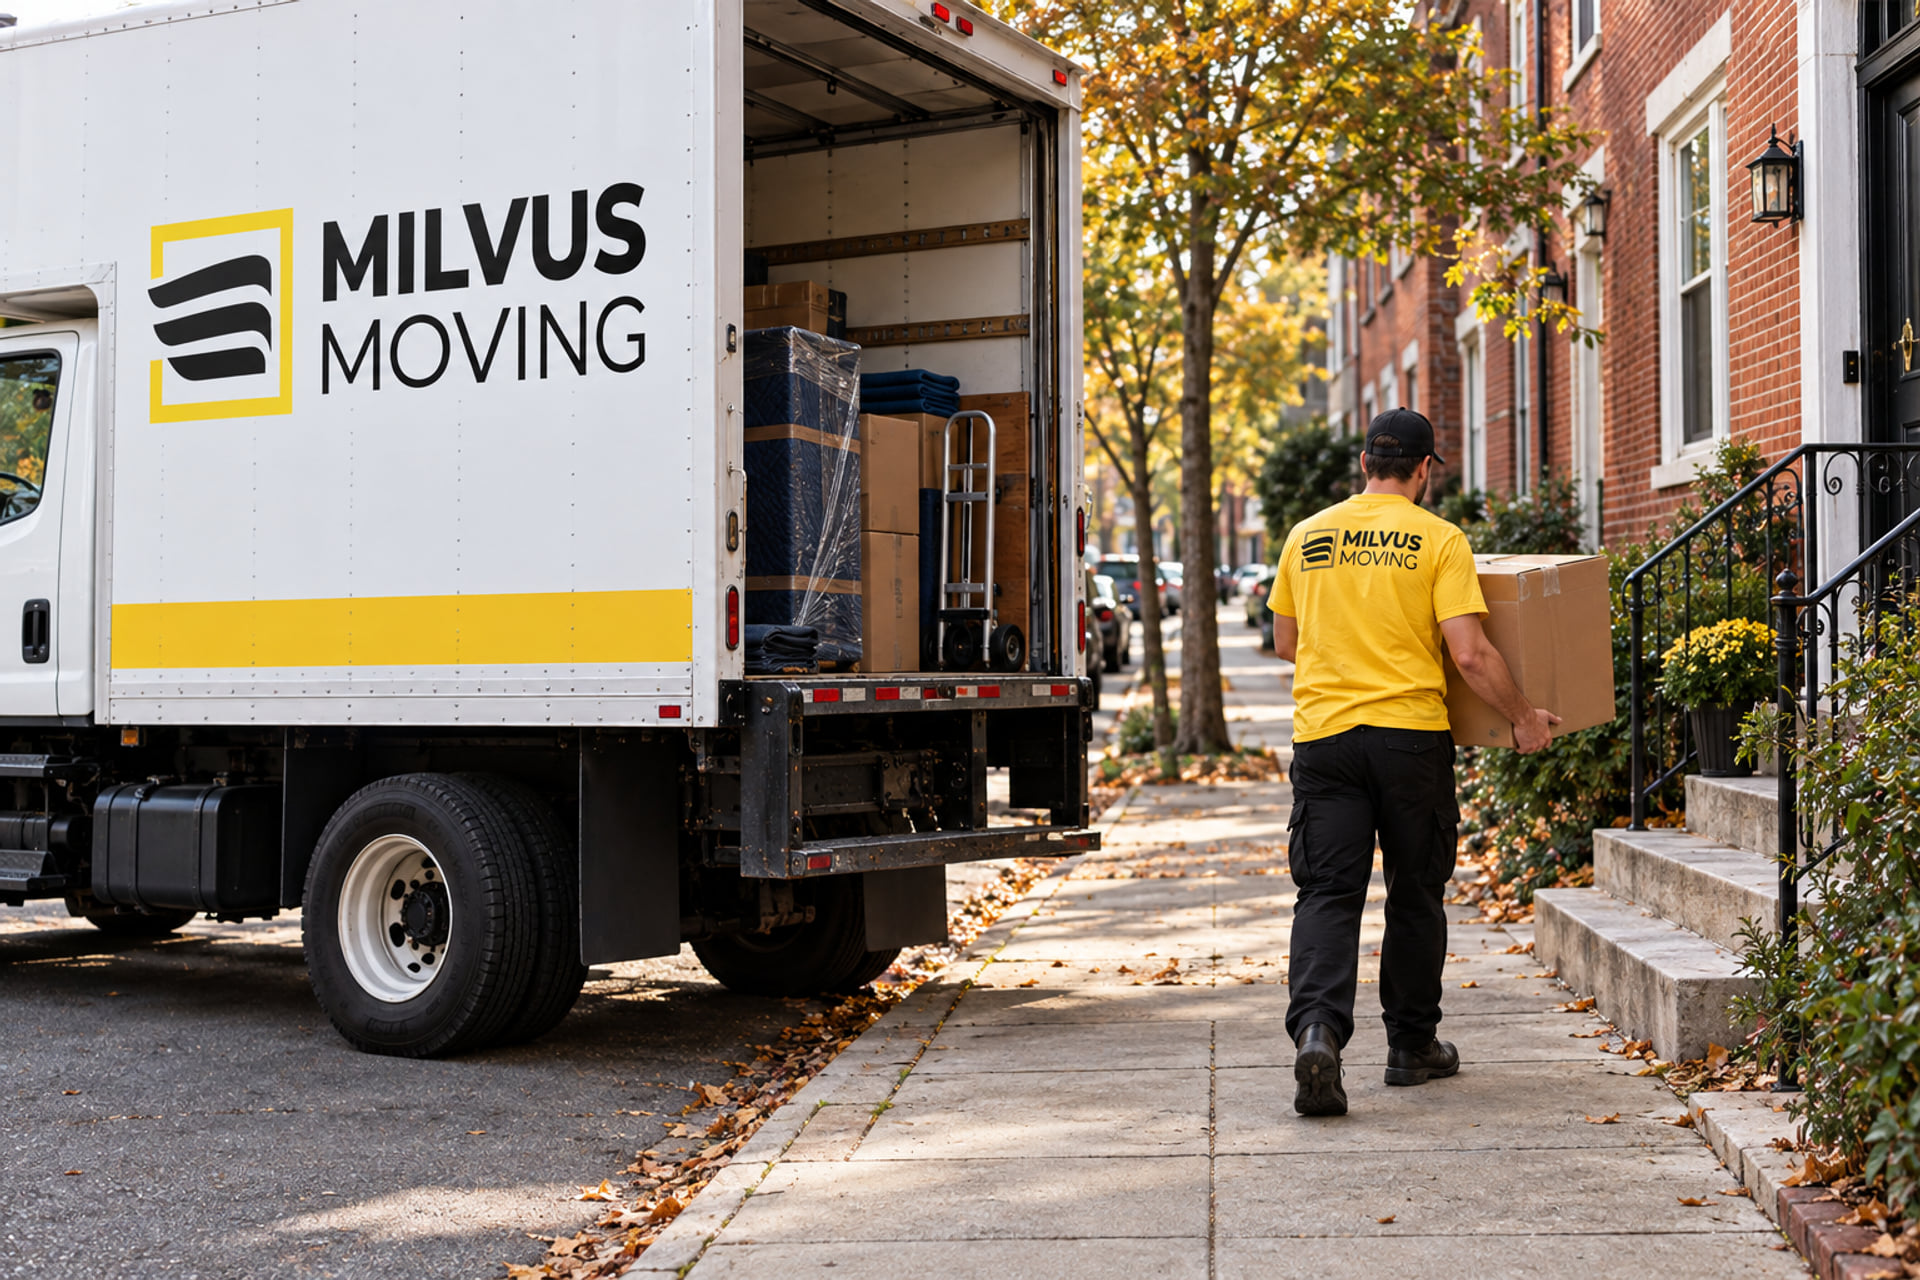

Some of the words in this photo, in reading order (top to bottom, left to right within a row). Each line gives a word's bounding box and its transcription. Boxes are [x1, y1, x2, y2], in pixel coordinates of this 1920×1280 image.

[322, 182, 647, 303] MILVUS
[321, 295, 647, 395] MOVING
[1339, 549, 1418, 571] MOVING
[1342, 529, 1423, 552] MILVUS
